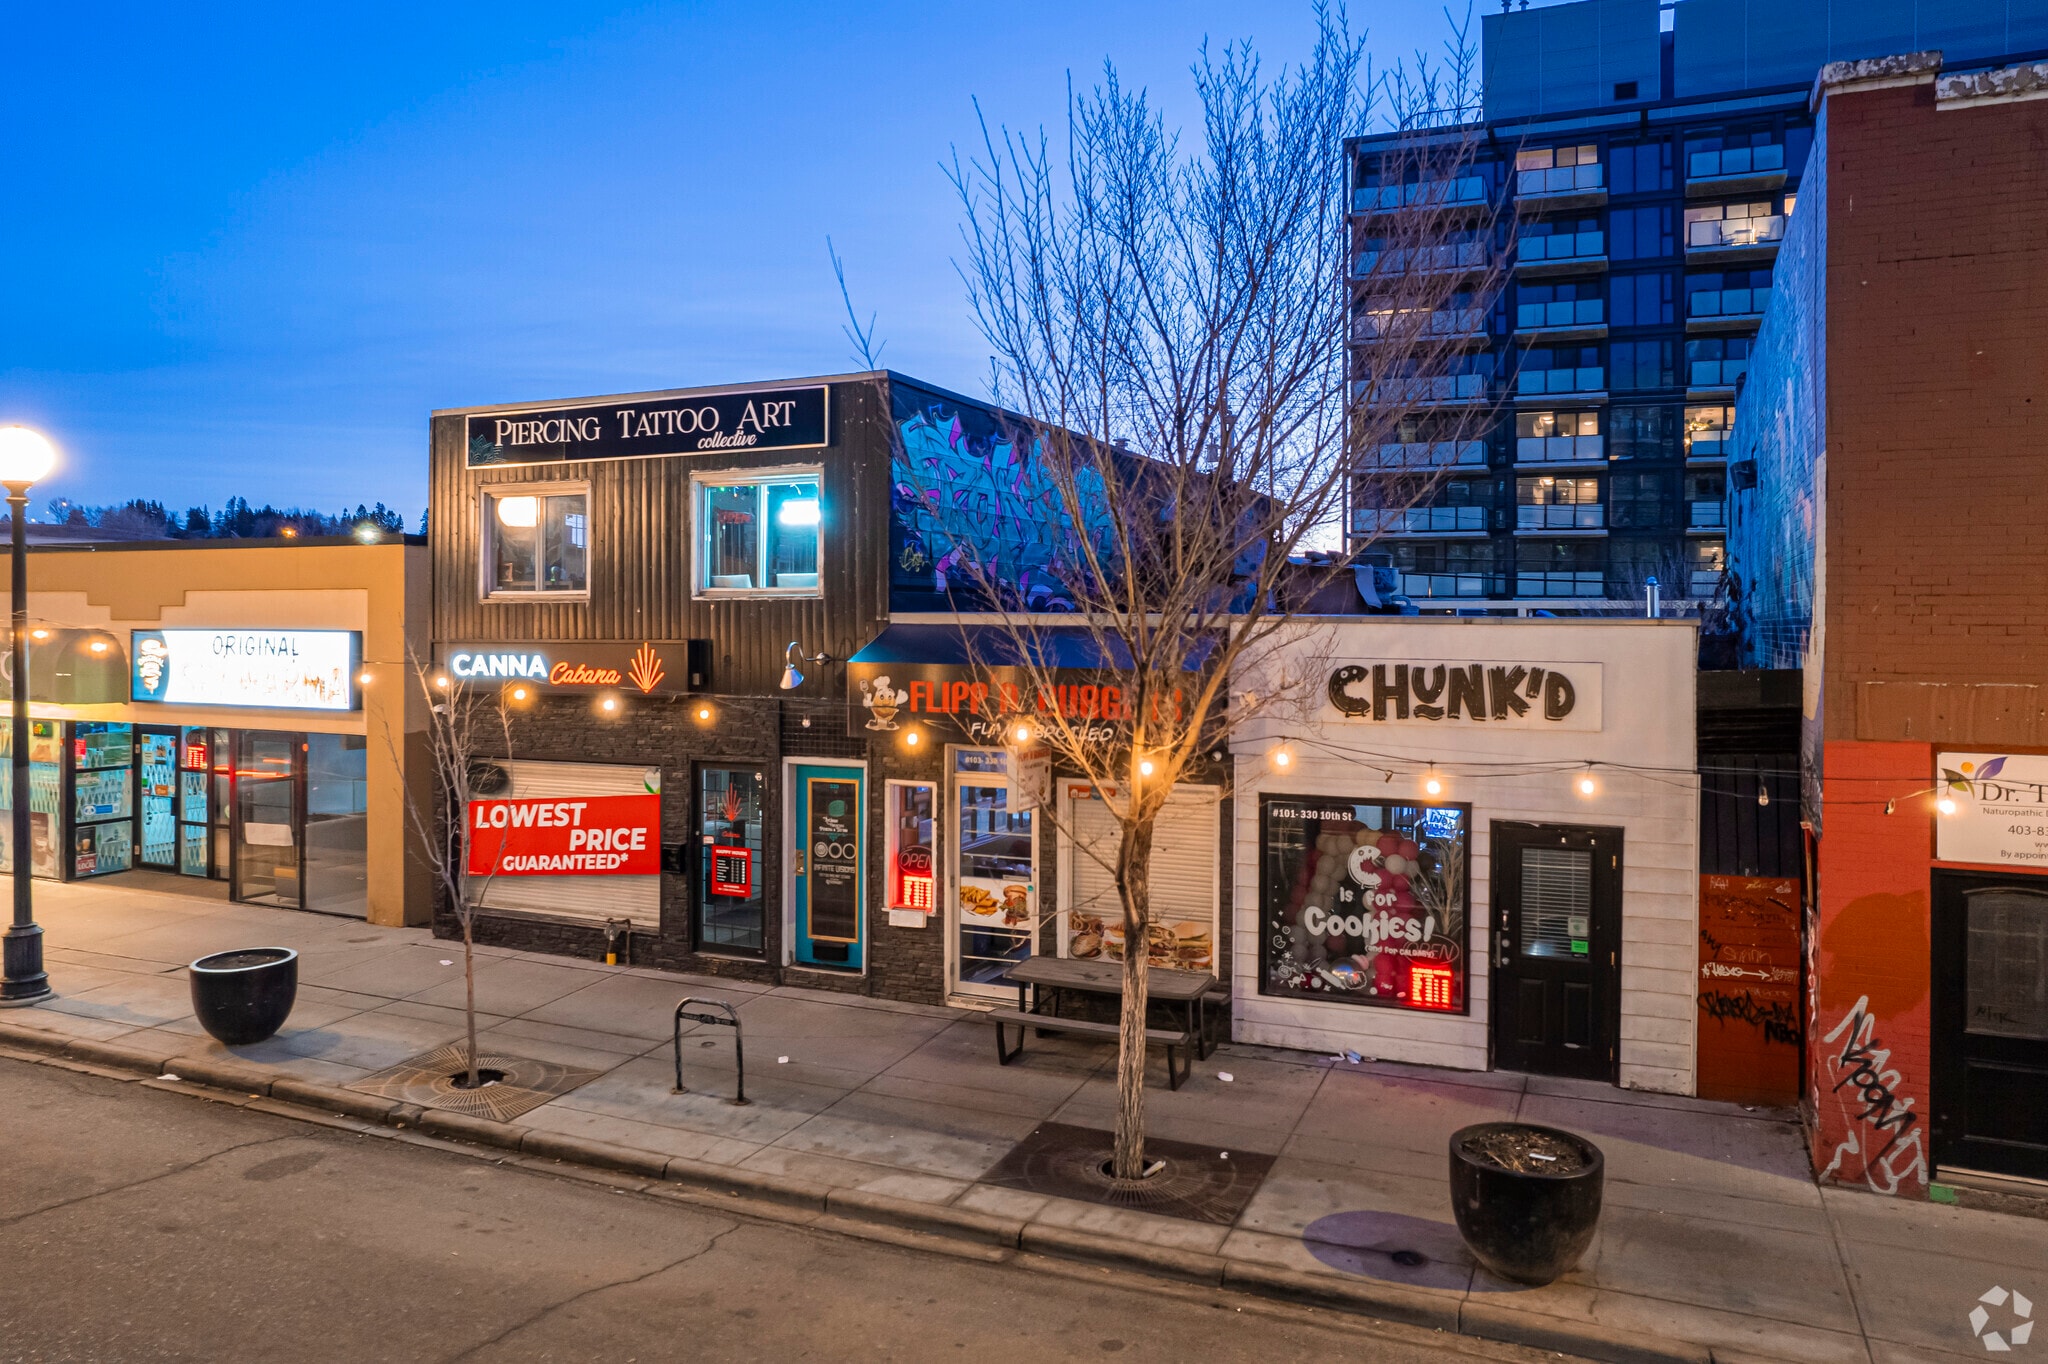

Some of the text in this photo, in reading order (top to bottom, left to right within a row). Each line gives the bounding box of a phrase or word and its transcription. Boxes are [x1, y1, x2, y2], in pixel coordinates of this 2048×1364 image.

[697, 429, 757, 450] collective
[212, 635, 300, 657] ORIGINAL
[452, 654, 622, 685] CANNA Cabana
[1328, 664, 1576, 721] CHUNK'D
[1980, 782, 2019, 802] Dr.
[475, 802, 587, 829] LOWEST
[1300, 809, 1318, 819] 330
[1320, 811, 1340, 820] 10th
[1342, 812, 1352, 821] St
[1982, 807, 2043, 818] Naturopathic
[569, 827, 647, 852] PRICE
[2000, 850, 2012, 859] By
[1304, 905, 1436, 945] Cookies!
